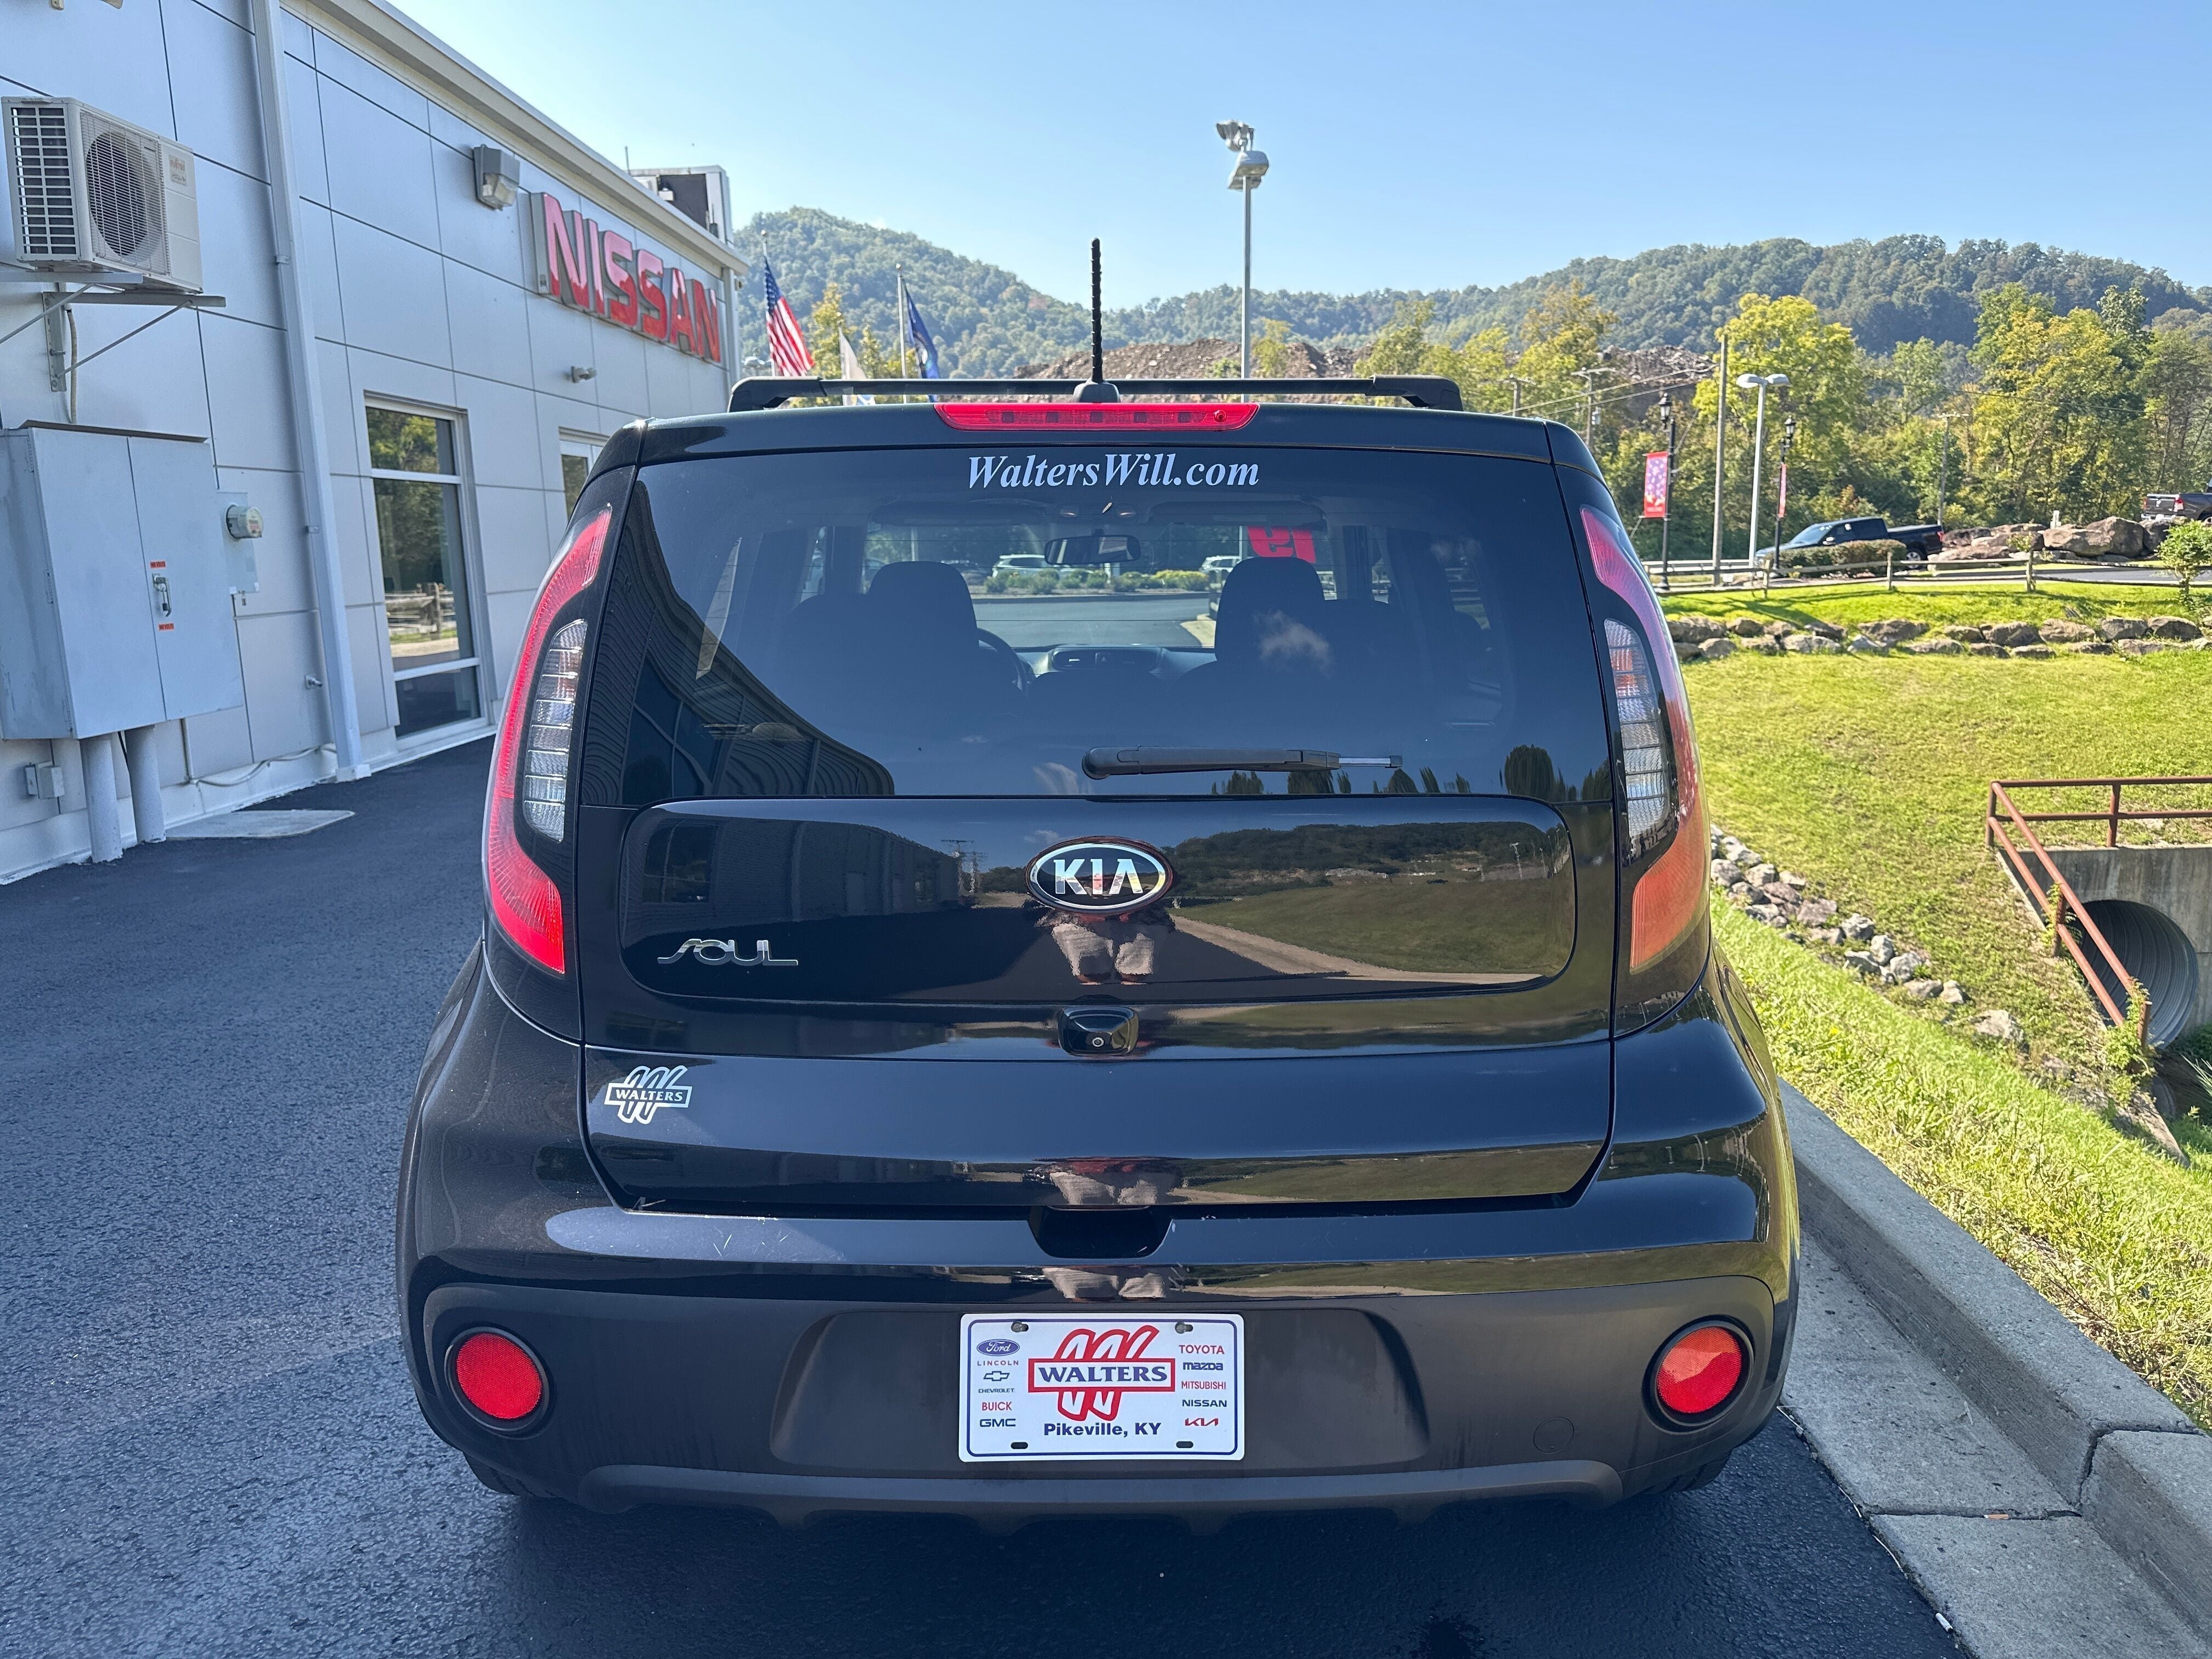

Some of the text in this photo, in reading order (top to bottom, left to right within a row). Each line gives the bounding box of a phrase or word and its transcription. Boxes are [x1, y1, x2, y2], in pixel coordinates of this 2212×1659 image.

[542, 193, 721, 363] NISSAN
[969, 453, 1259, 488] WaltersWill.com
[1053, 859, 1143, 895] KIA
[658, 938, 798, 966] SOUL
[616, 1088, 683, 1102] WALTERS
[986, 1340, 1012, 1352] Ford
[1179, 1345, 1224, 1355] TOYOTA
[1037, 1366, 1167, 1383] WALTERS
[1181, 1381, 1226, 1390] MITSUBISHI
[981, 1402, 1012, 1411] BUICK
[979, 1418, 1016, 1427] GMC
[1044, 1422, 1161, 1438] Pikeville, KY
